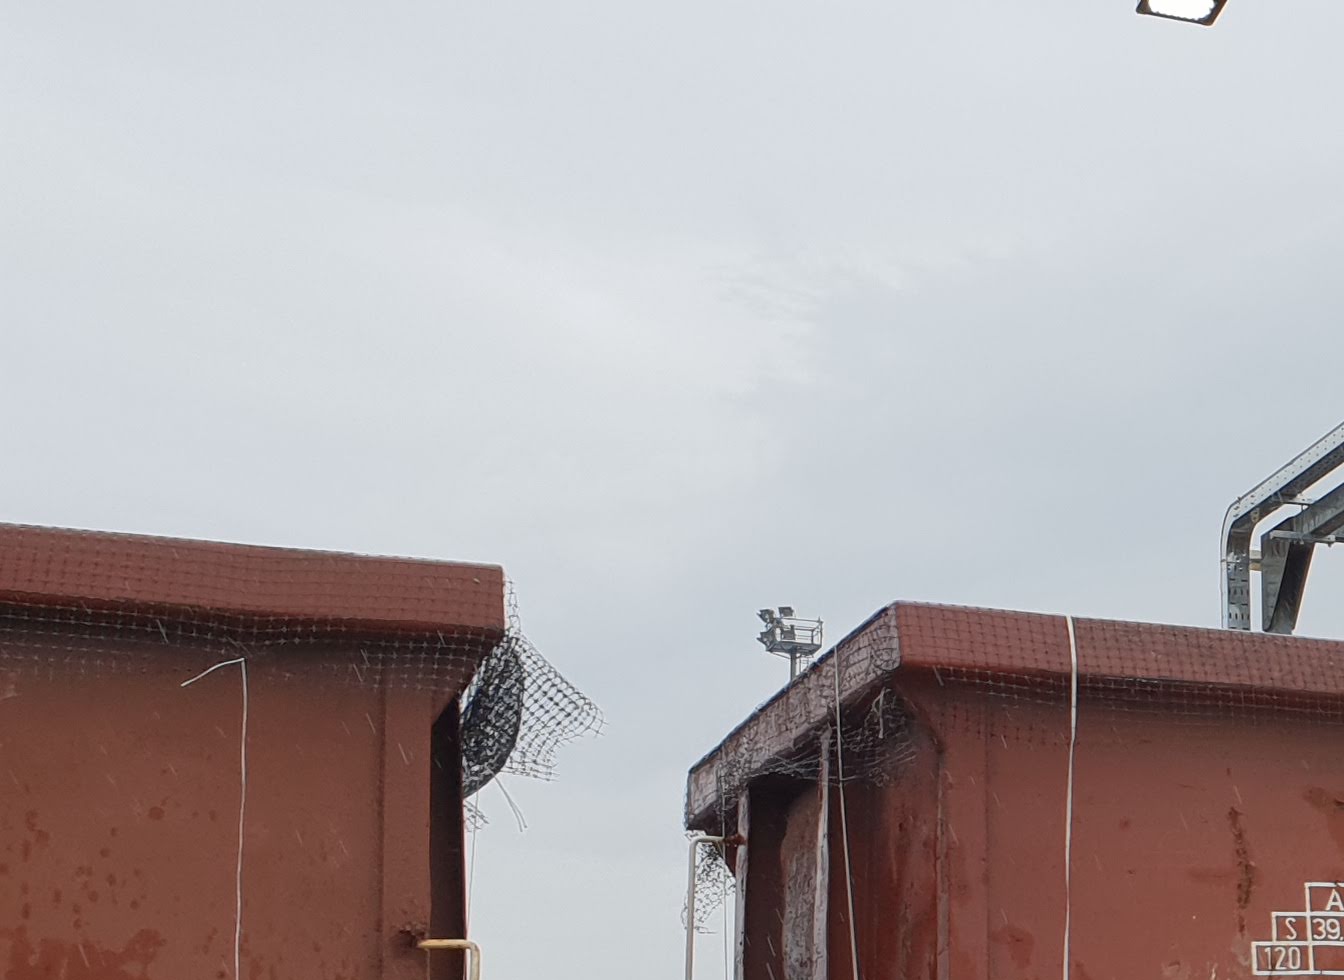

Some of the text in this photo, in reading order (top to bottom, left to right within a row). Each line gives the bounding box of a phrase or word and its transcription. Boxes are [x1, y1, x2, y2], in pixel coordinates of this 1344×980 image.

[1324, 888, 1344, 912] A
[1285, 917, 1298, 941] S
[1264, 946, 1301, 971] 120
